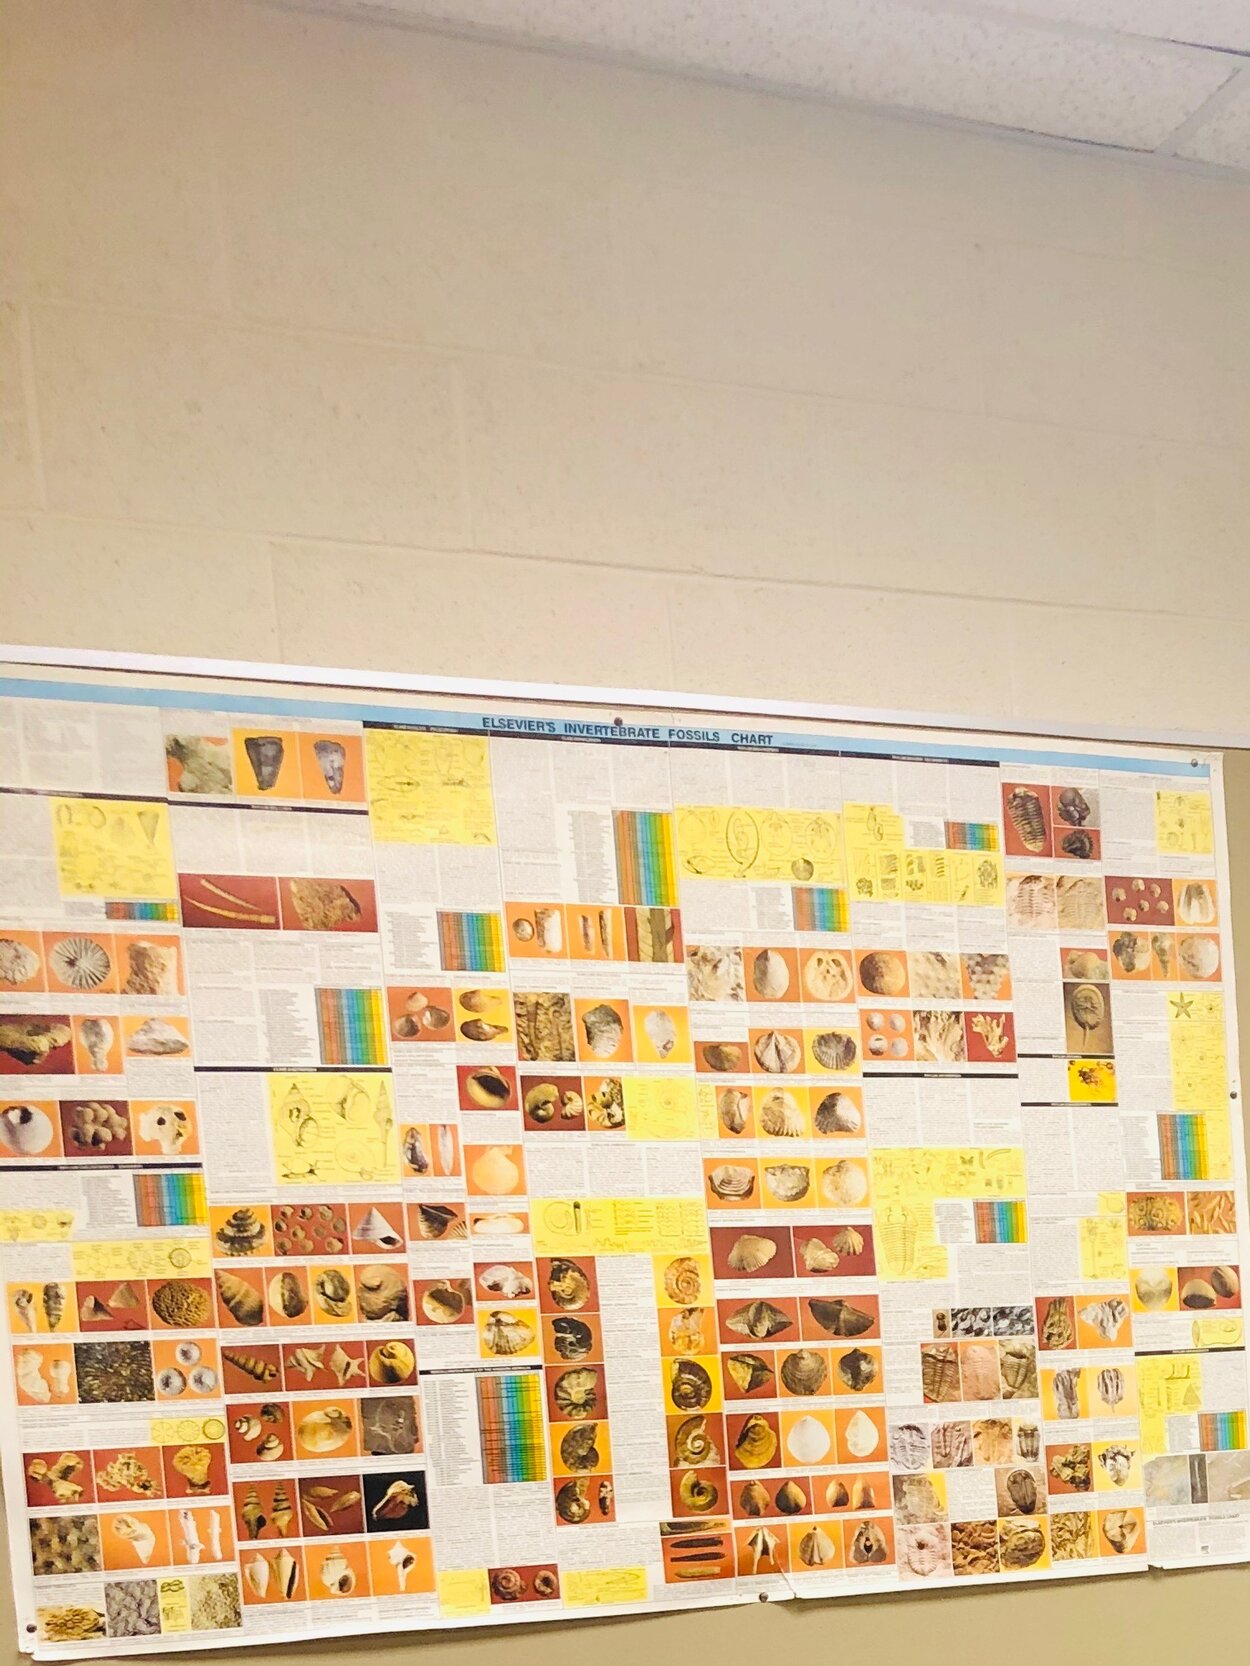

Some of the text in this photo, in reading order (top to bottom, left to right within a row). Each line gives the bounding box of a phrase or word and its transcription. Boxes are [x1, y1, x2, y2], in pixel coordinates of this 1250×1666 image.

[482, 717, 556, 733] ELSEVIER'S
[564, 723, 660, 739] INVERTEBRATE
[668, 729, 720, 743] FOSSILS
[731, 733, 773, 746] CHART
